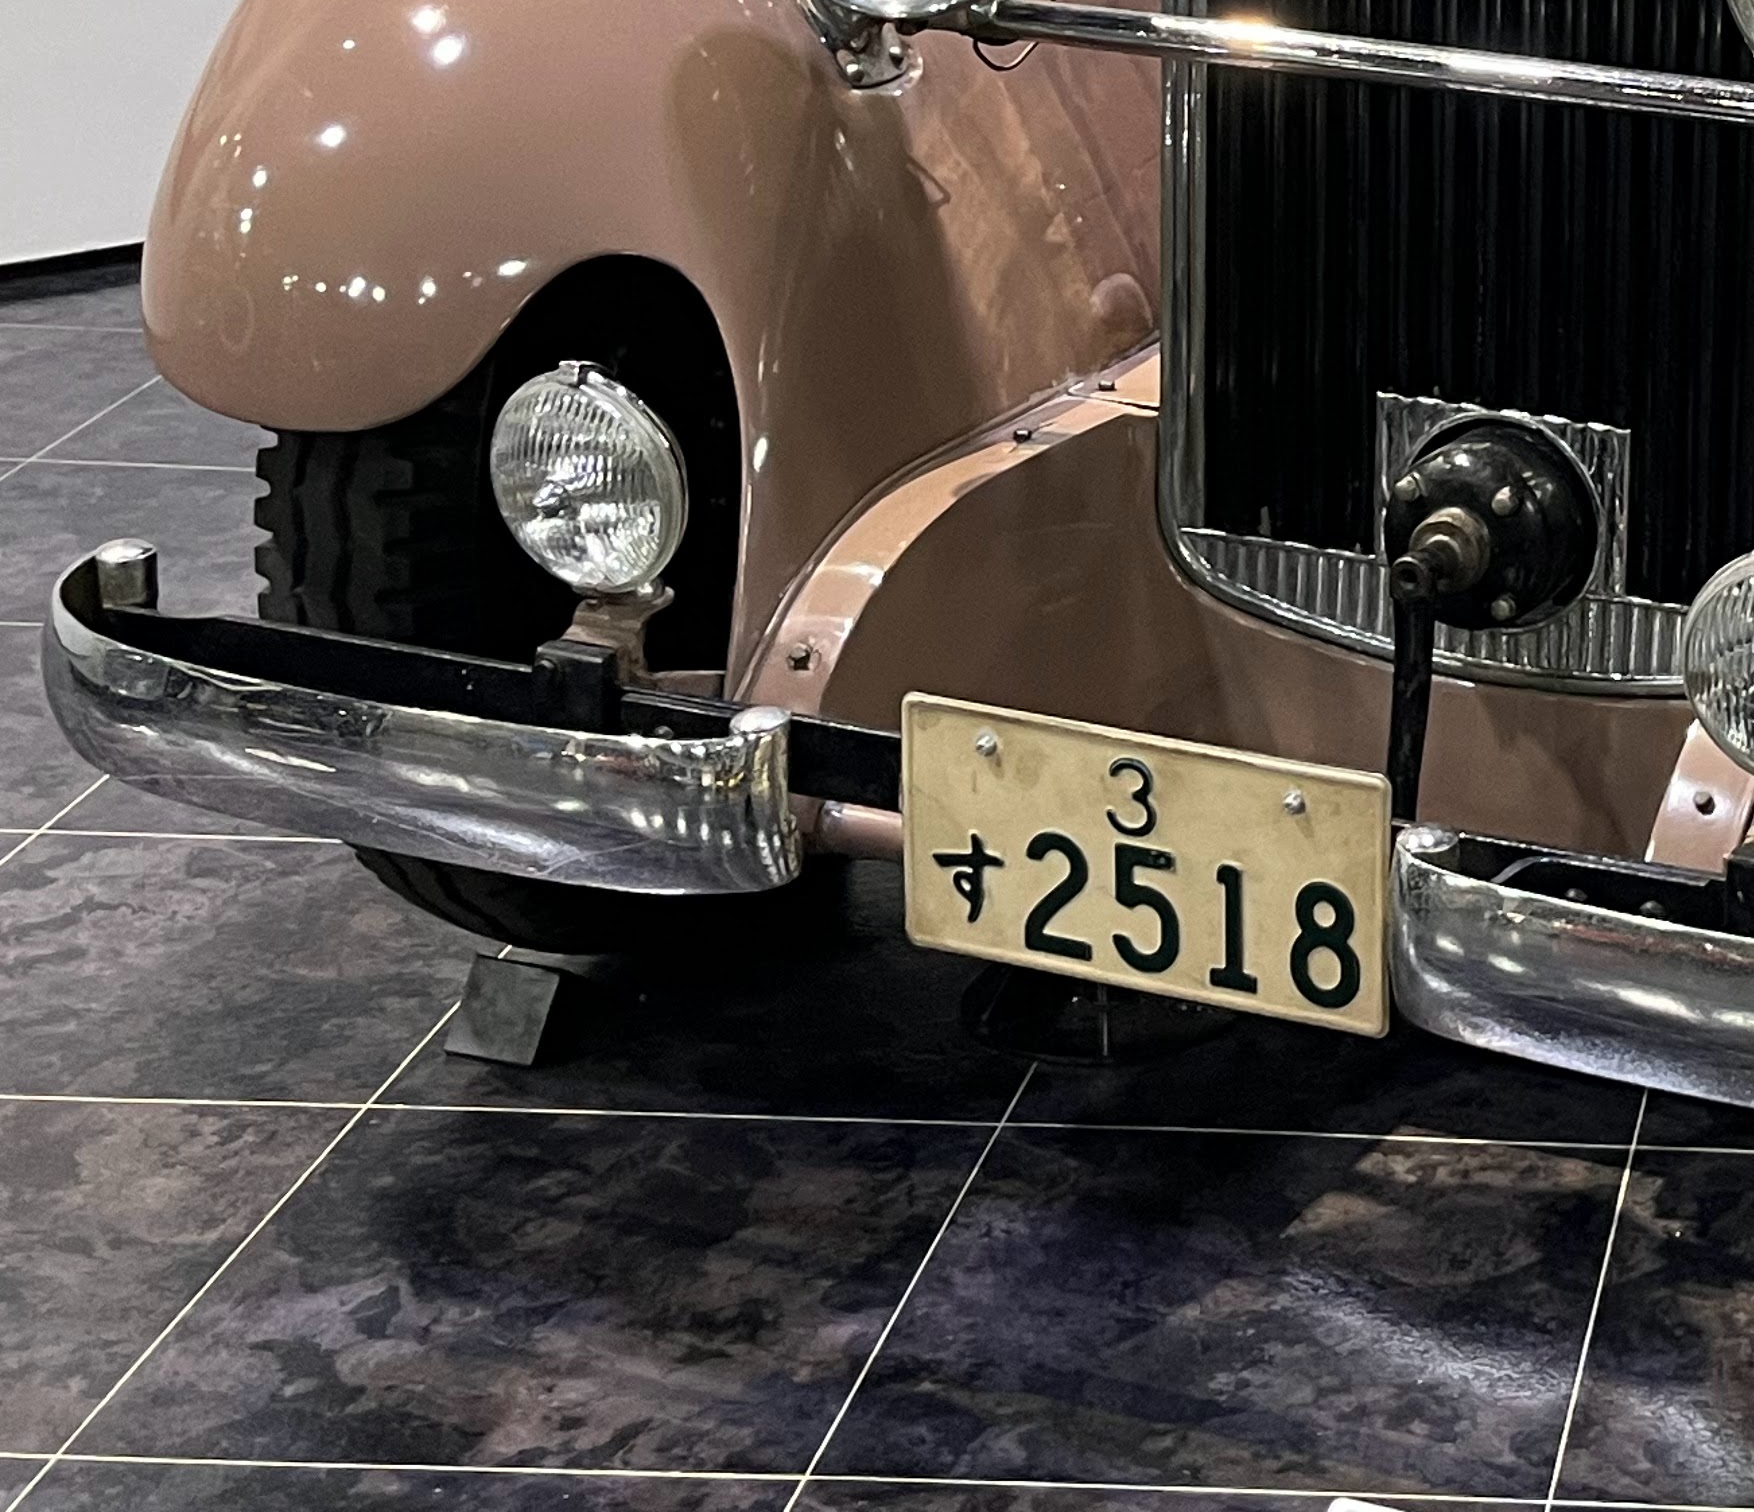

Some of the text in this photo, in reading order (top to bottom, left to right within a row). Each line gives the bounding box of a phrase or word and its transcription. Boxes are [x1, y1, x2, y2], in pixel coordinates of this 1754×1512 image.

[1106, 756, 1157, 838] 3
[932, 831, 1361, 1009] す 2518
